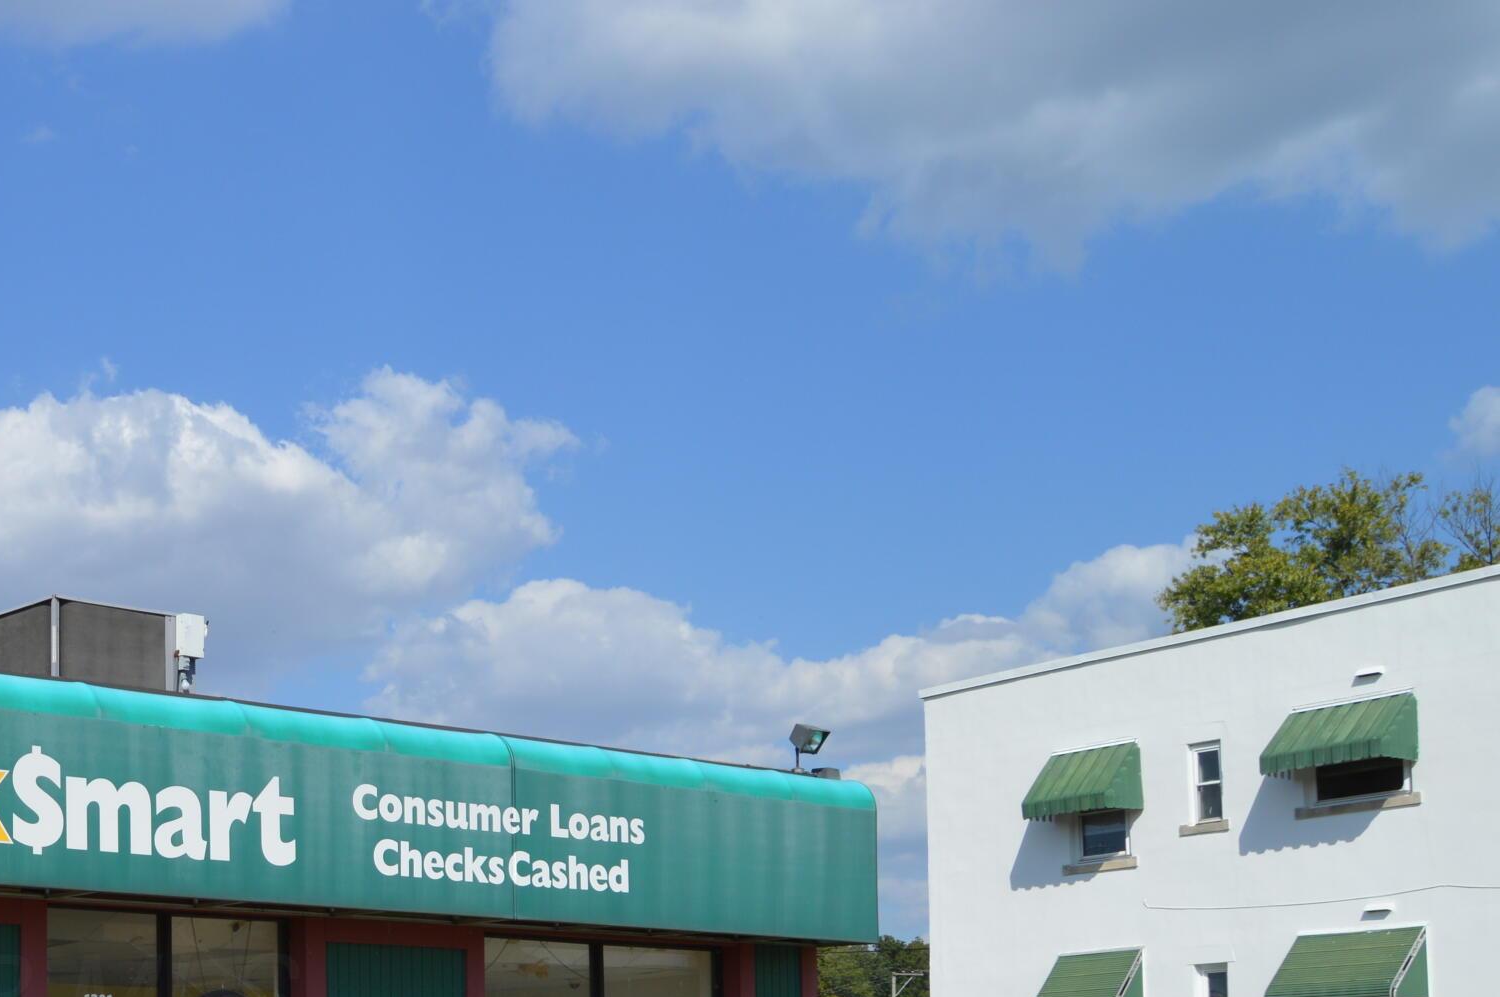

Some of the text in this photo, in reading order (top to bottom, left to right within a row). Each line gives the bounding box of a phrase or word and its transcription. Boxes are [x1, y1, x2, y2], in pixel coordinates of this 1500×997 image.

[352, 783, 645, 845] Consumer Loans
[373, 838, 630, 893] Checks Cashed
